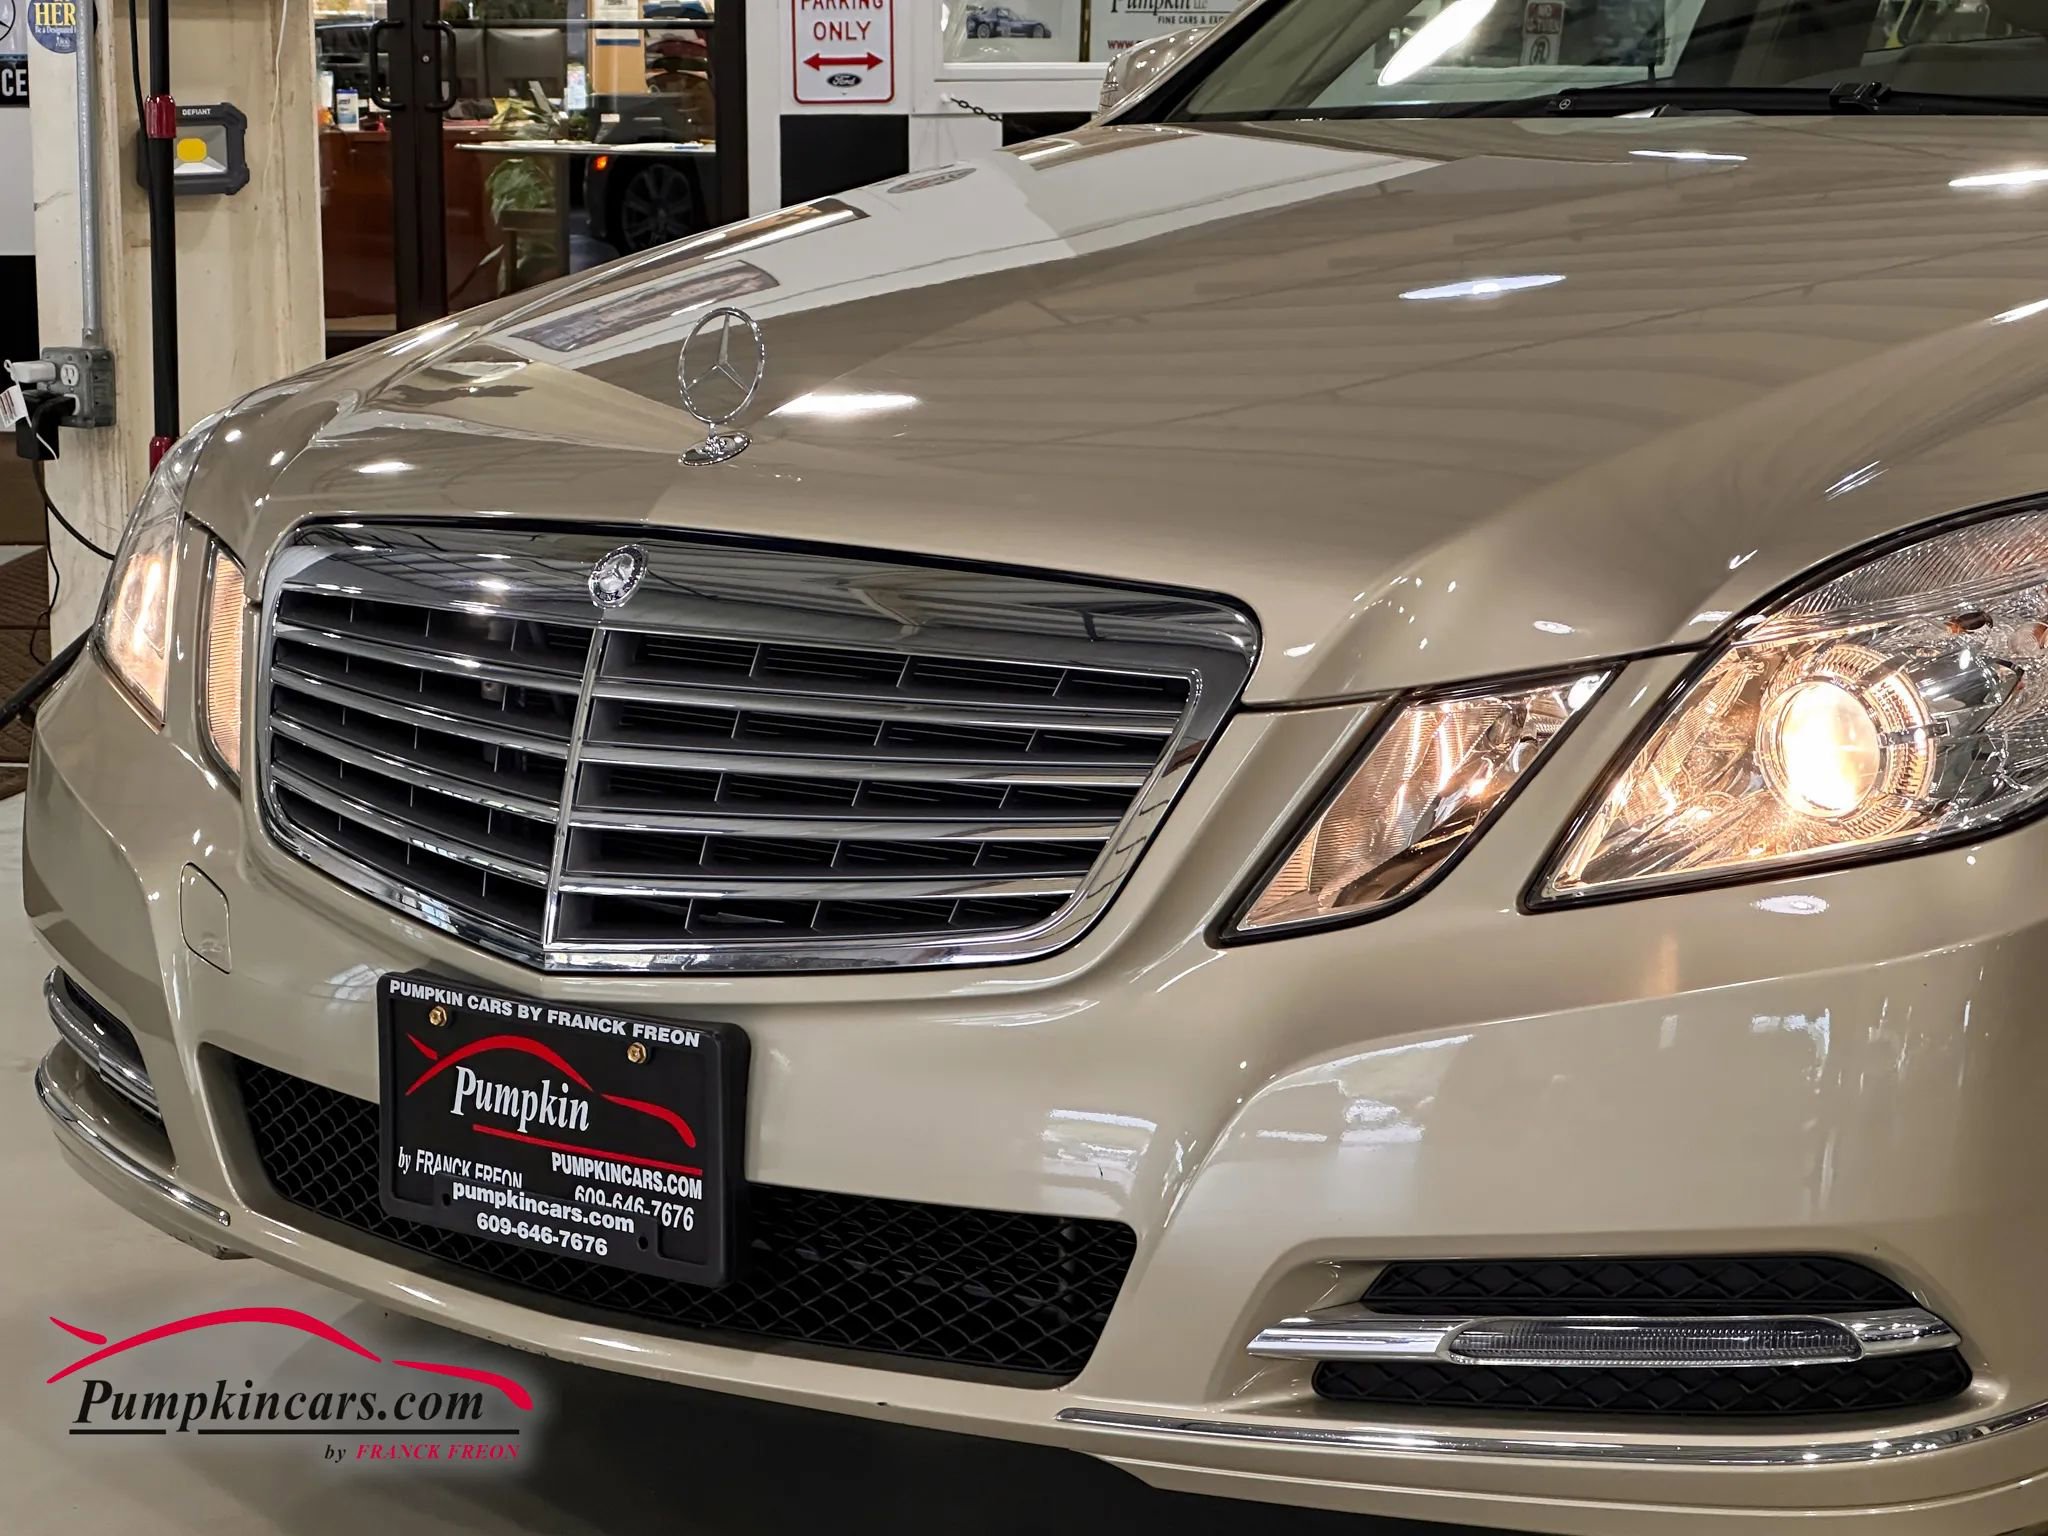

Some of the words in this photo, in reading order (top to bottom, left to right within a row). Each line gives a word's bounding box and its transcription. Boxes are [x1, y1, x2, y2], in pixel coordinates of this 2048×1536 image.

[813, 21, 871, 41] ONLY
[1158, 15, 1176, 25] FINE
[1179, 15, 1198, 25] CARS
[1, 69, 28, 97] CE
[832, 75, 857, 85] Ford
[181, 108, 212, 116] DEFIANT
[390, 979, 463, 1007] PUMPKIN
[467, 994, 513, 1017] CARS
[518, 1004, 543, 1022] BY
[547, 1010, 626, 1036] FRANCK
[633, 1023, 700, 1048] FREON
[450, 1065, 590, 1133] Pumpkin
[398, 1146, 412, 1175] by
[415, 1149, 472, 1178] FRANCK
[551, 1151, 703, 1200] PUMPKINCARS.COM
[452, 1181, 635, 1234] pumpkincars.com
[476, 1212, 608, 1256] 609-646-7676
